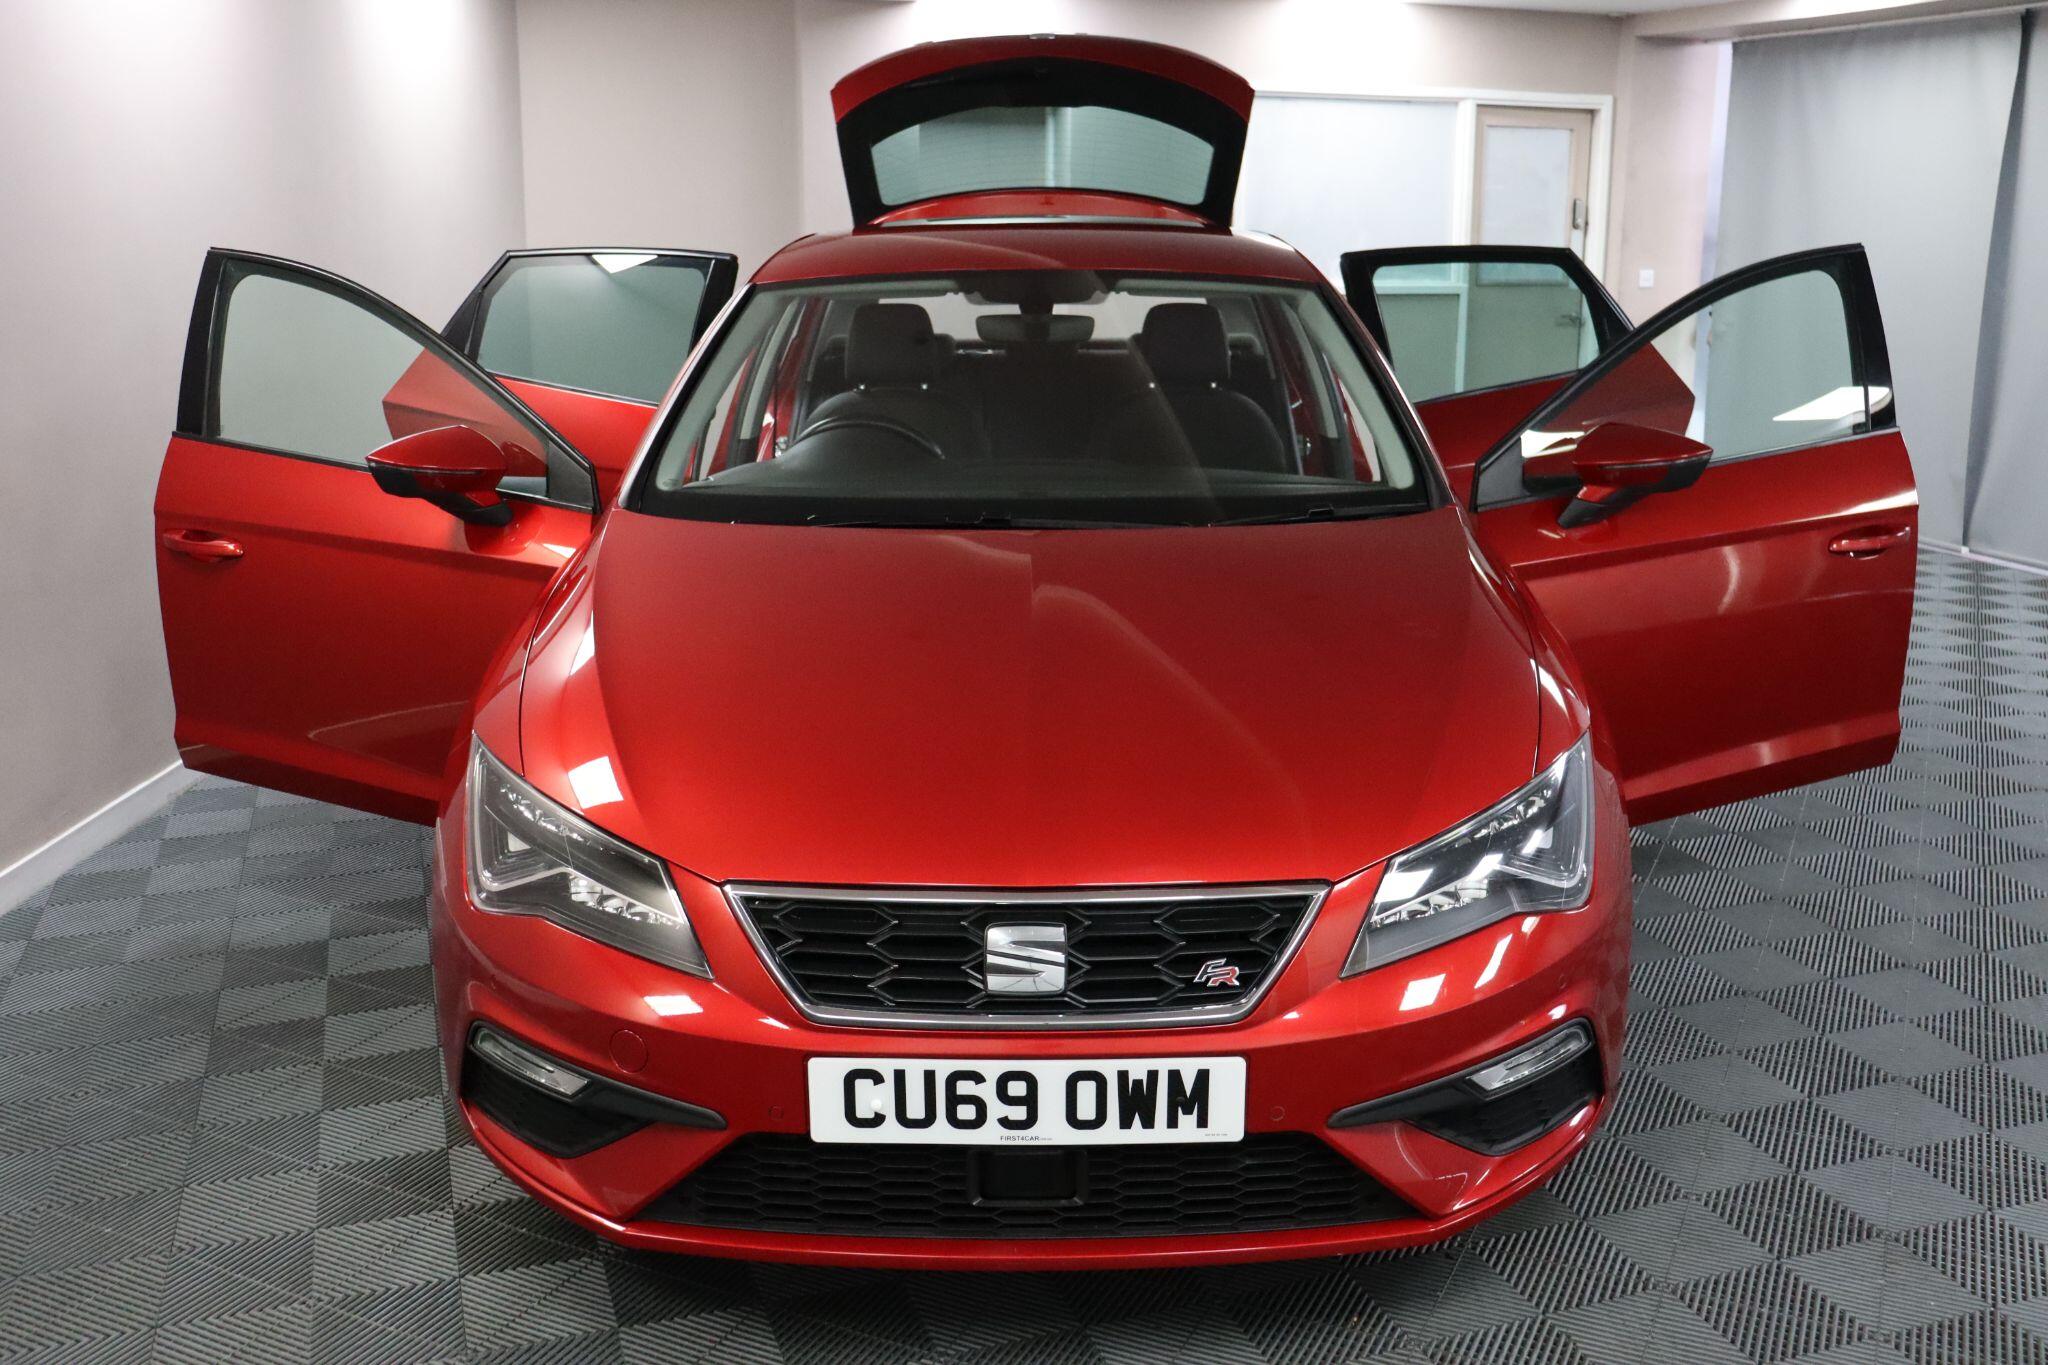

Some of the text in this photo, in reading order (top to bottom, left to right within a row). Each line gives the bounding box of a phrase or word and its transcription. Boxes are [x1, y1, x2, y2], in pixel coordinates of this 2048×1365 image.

[1193, 957, 1240, 987] FR
[843, 1068, 1210, 1131] CU69 OWM
